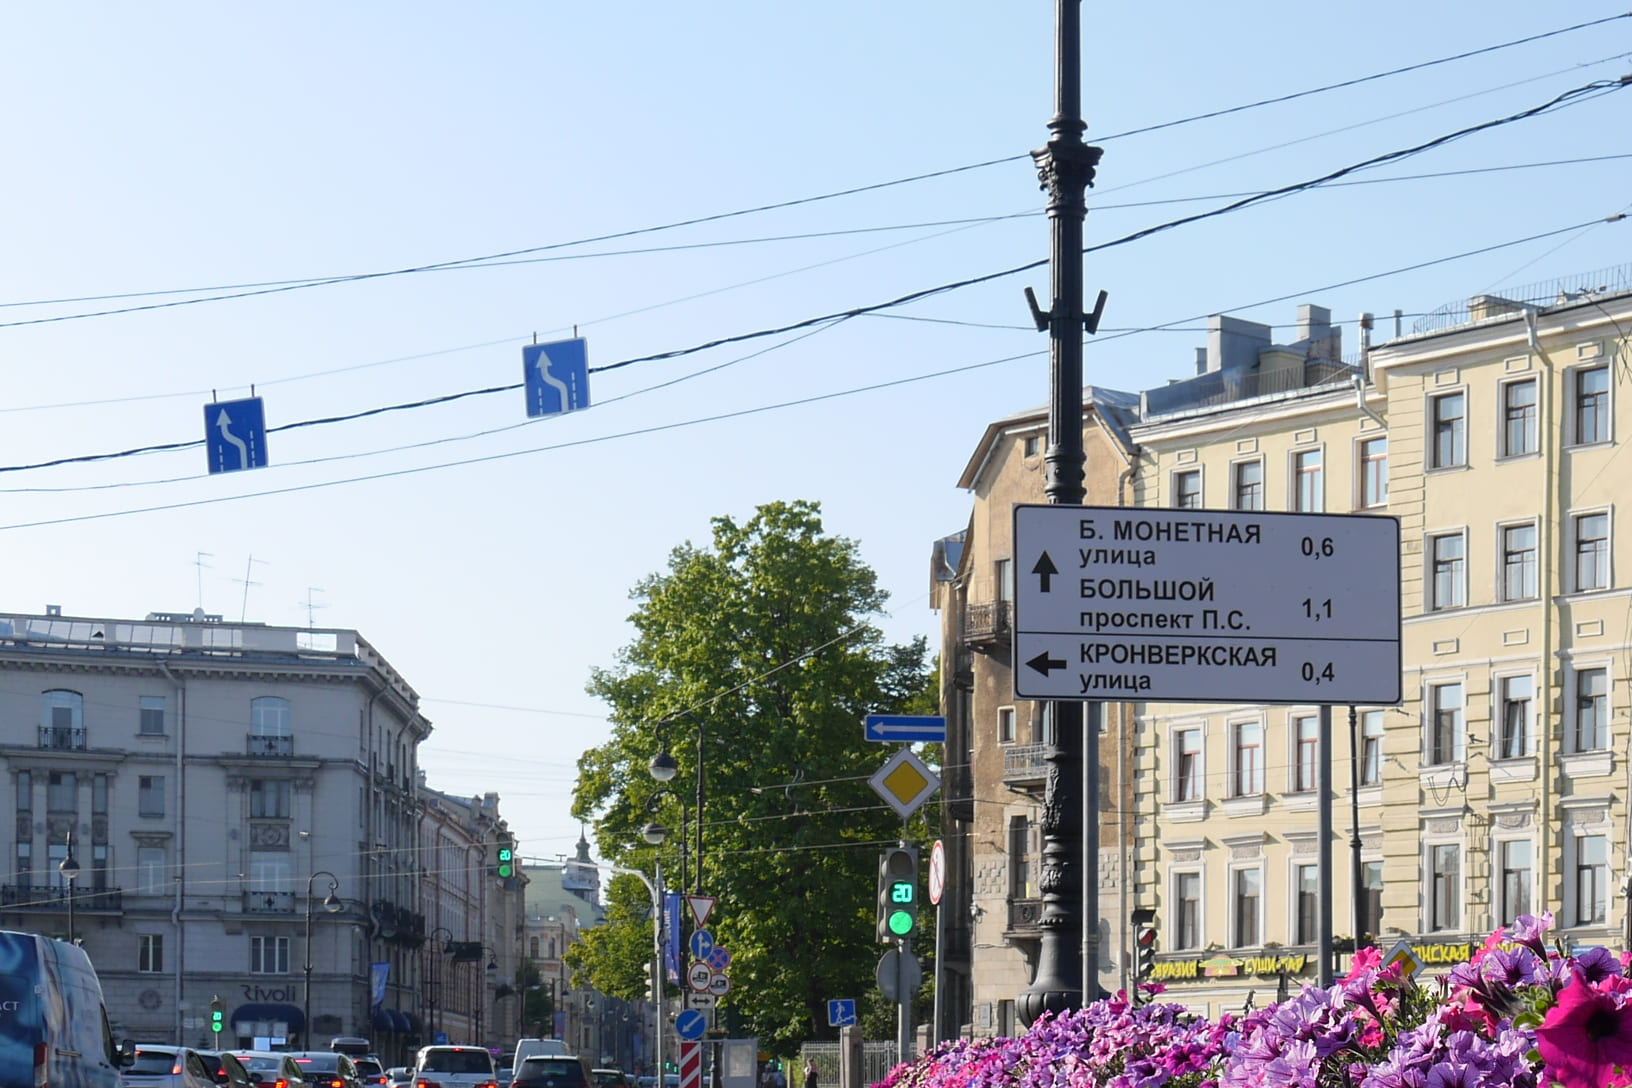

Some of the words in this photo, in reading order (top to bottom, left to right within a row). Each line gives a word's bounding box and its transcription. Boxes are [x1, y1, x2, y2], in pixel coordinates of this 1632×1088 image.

[1079, 519, 1104, 540] Б.
[1113, 521, 1261, 544] МОНЕТНАЯ
[1079, 548, 1156, 568] улица
[1301, 536, 1334, 561] 0,6
[1080, 577, 1214, 602] БОЛЬШОЙ
[1079, 611, 1193, 632] проспект
[1202, 609, 1251, 631] П.С.
[1302, 598, 1333, 621] 1,1
[1080, 643, 1277, 667] КРОНВЕРКСКАЯ
[1079, 672, 1152, 694] улица
[1301, 661, 1335, 685] 0,4
[892, 883, 913, 902] 20
[240, 984, 296, 1001] Rivoli
